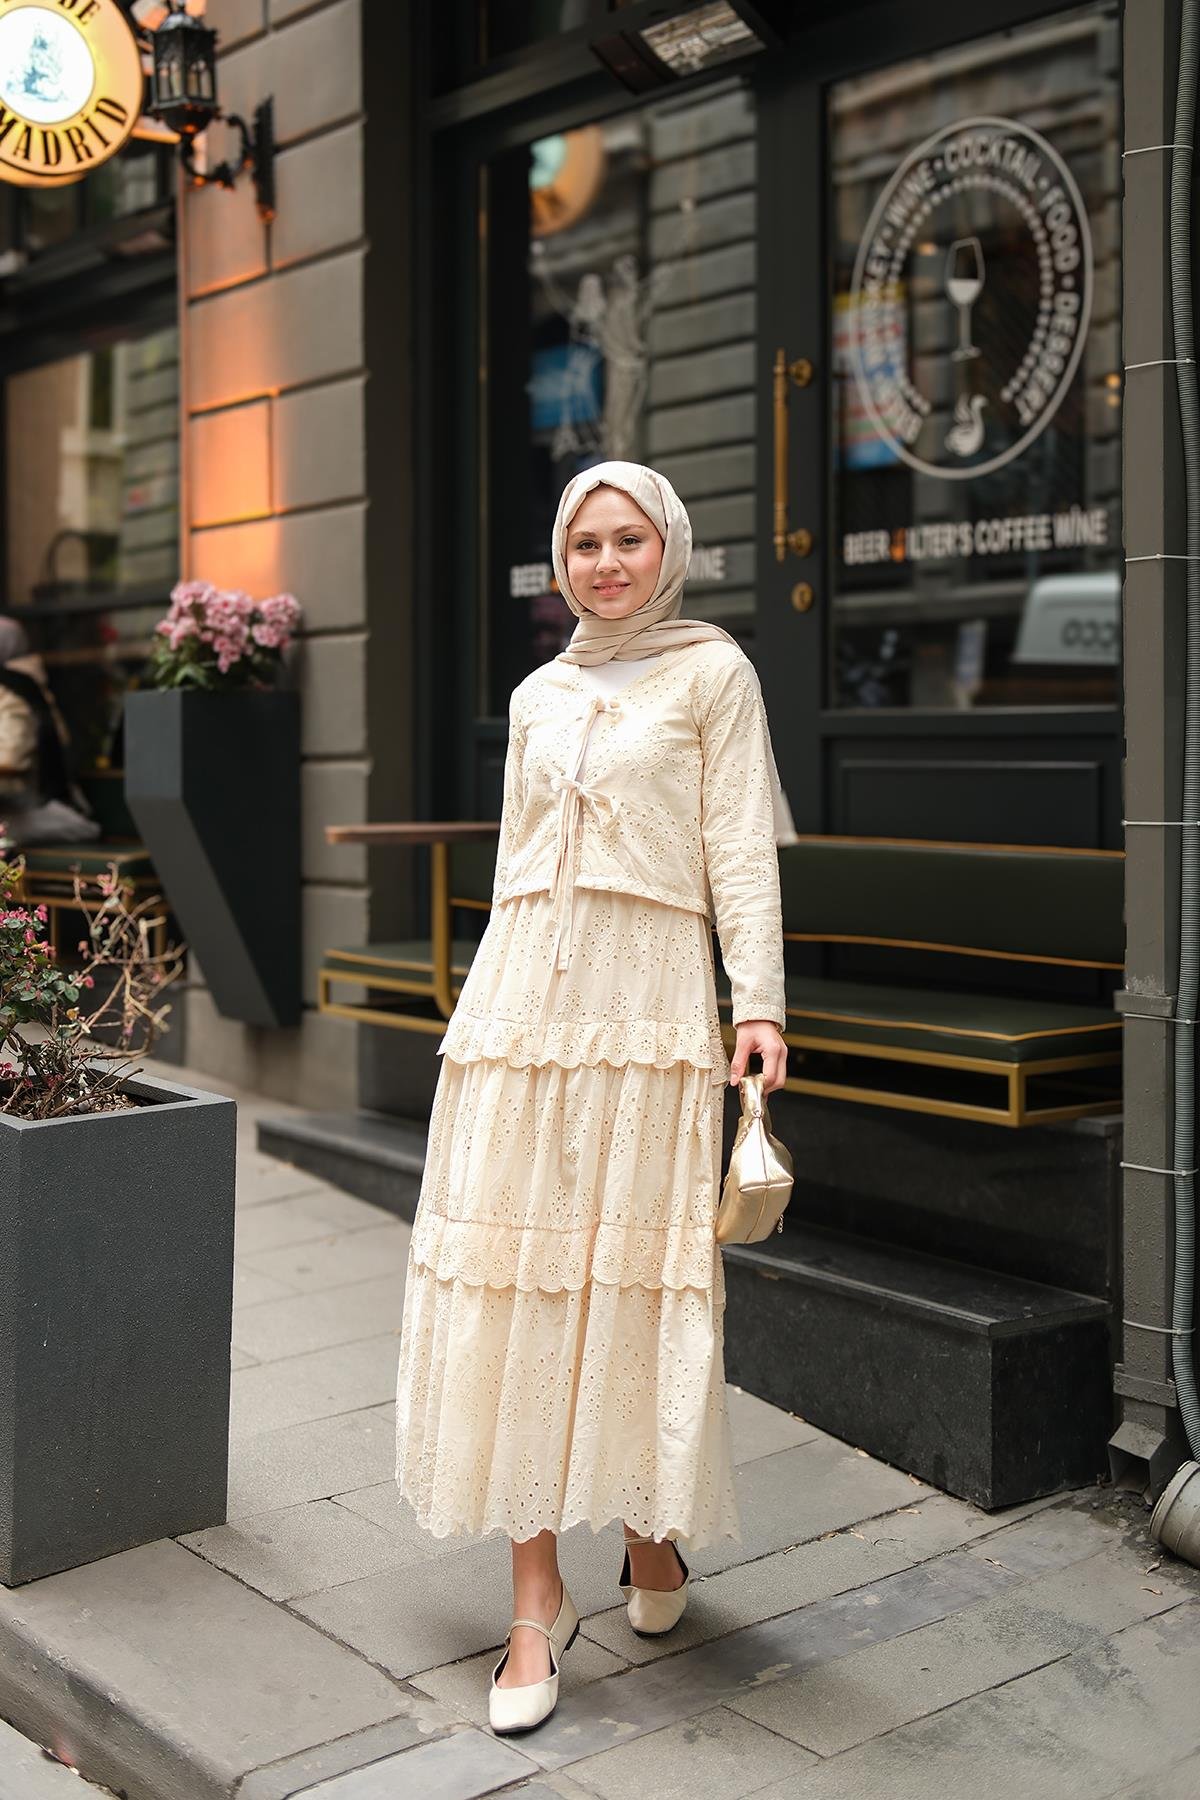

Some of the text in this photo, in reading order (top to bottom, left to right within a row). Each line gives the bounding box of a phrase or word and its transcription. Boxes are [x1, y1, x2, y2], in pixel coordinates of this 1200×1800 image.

[944, 135, 1043, 192] COCKTAIL
[1041, 185, 1080, 273] FOOD
[973, 514, 1052, 555] COFFEE
